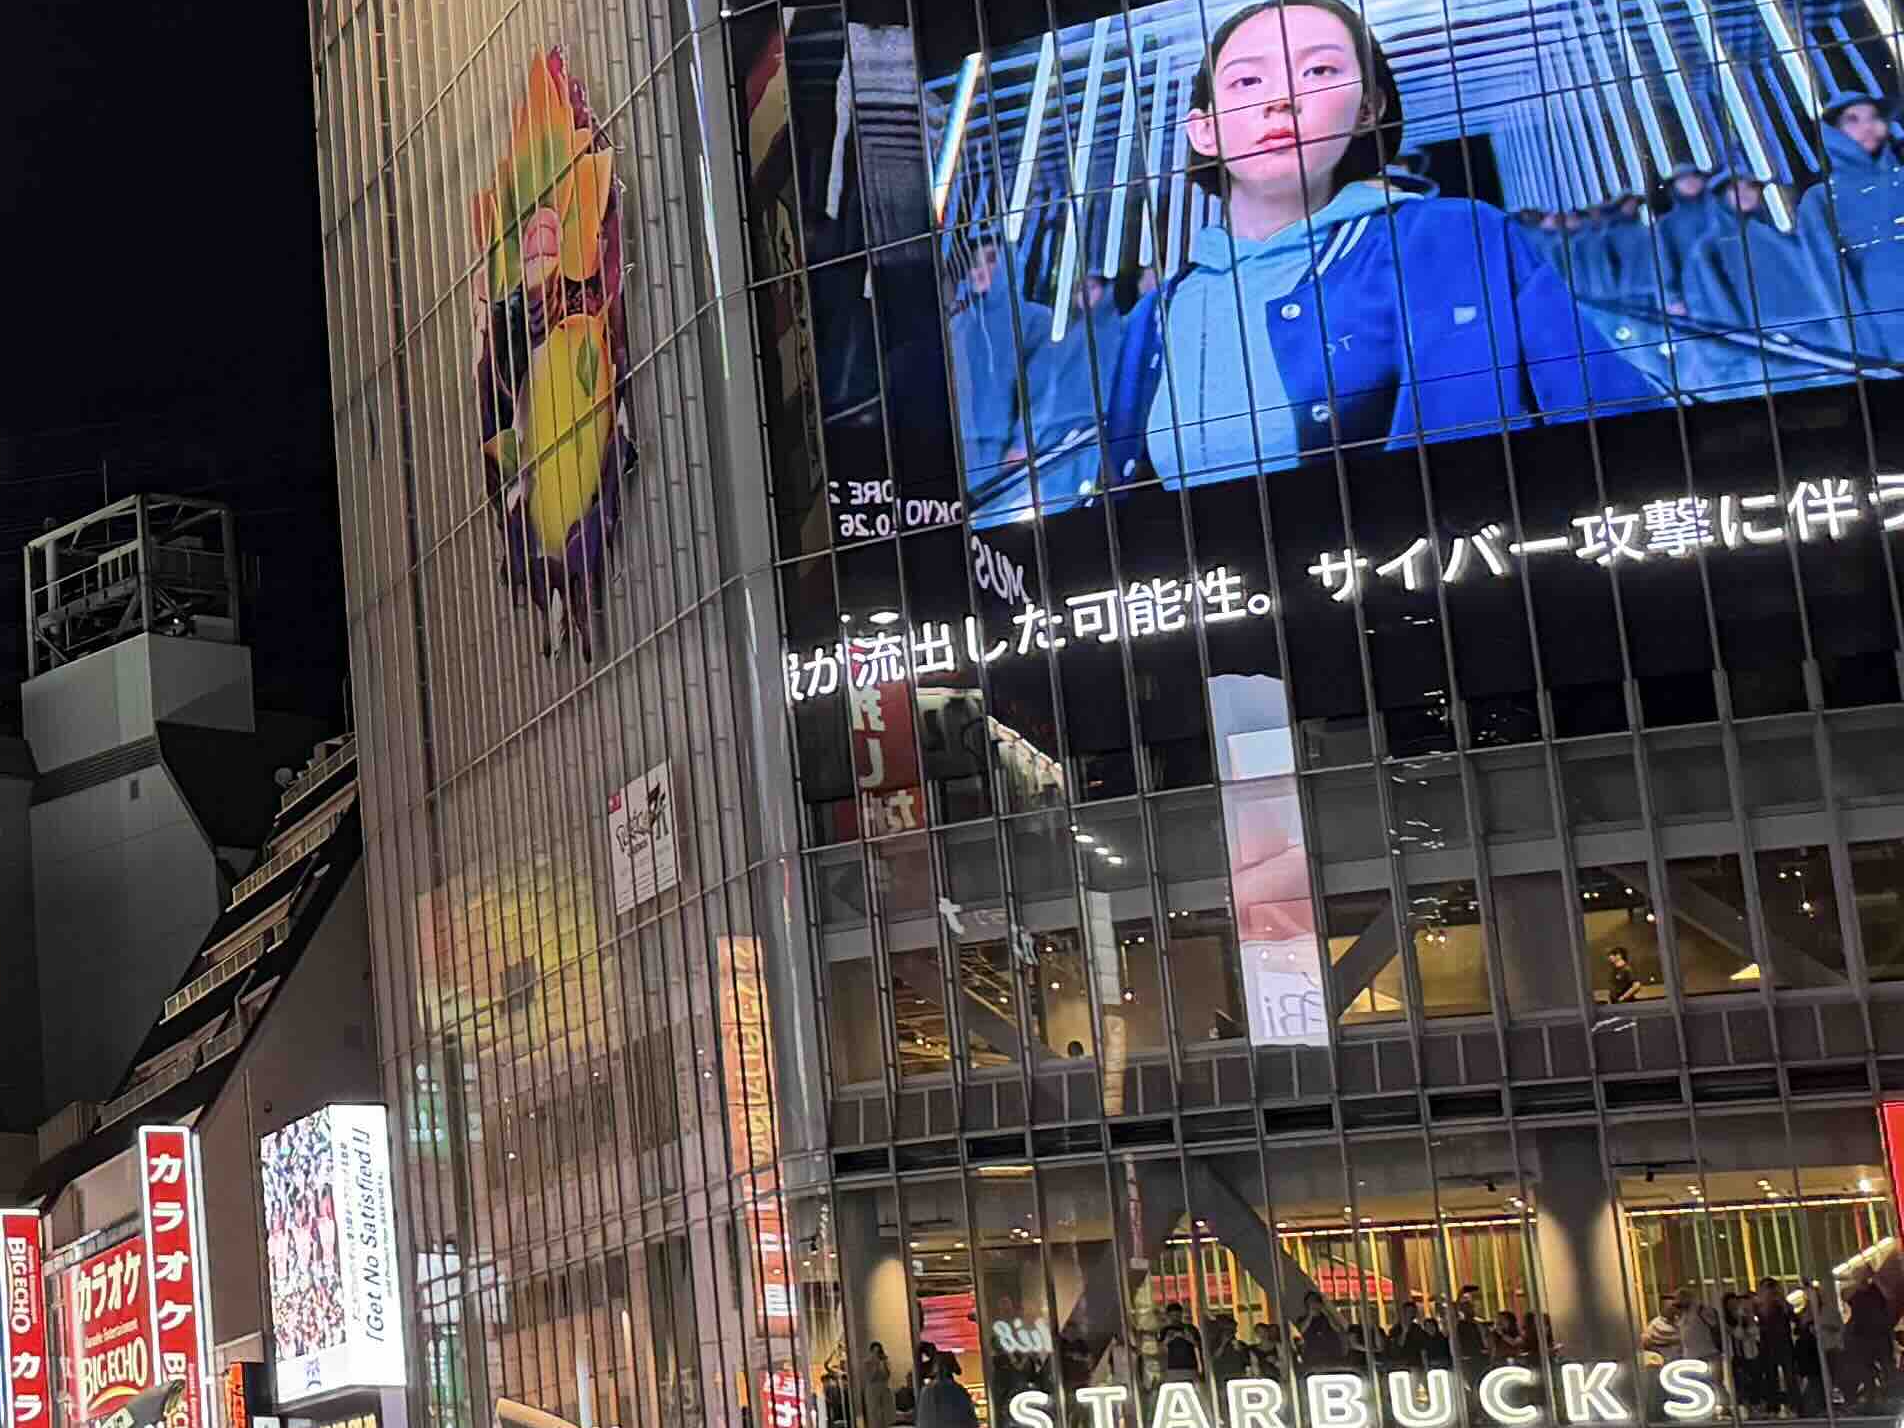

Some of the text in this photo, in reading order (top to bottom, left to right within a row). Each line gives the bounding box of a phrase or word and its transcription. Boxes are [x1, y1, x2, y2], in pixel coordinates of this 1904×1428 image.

[77, 1250, 143, 1323] カラオケ
[149, 1153, 193, 1332] カラオケ
